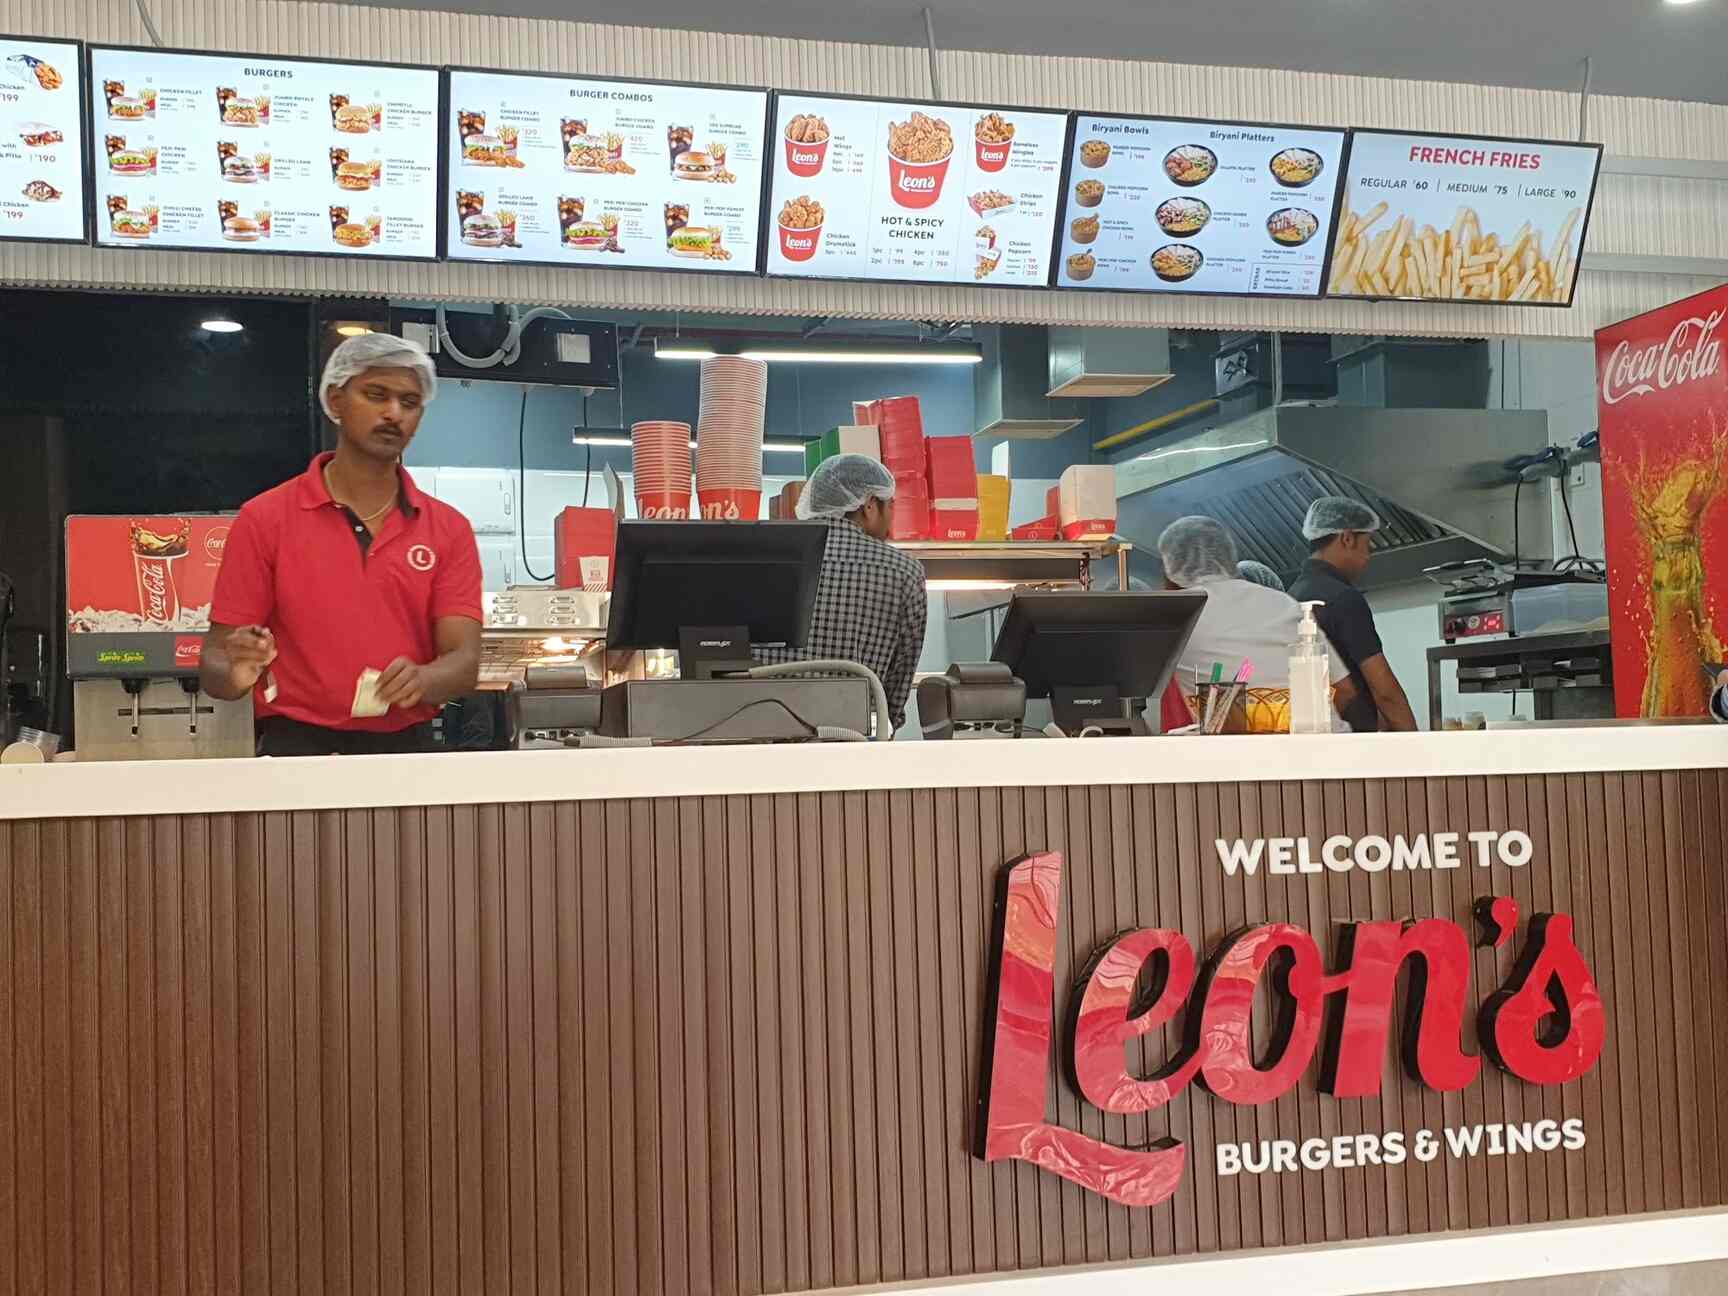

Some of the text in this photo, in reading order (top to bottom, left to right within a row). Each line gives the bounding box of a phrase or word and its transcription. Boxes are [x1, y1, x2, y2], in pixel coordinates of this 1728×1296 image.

[244, 68, 294, 79] BURGERS
[570, 88, 654, 102] BURGER COMBOS
[1092, 123, 1149, 134] Biryani Bowls
[1210, 130, 1275, 142] Biryani Platters
[1409, 146, 1541, 170] FRENCH FRIES
[898, 170, 936, 192] Leon's
[1360, 178, 1408, 189] REGULAR
[1446, 183, 1488, 194] MEDIUM
[1524, 187, 1556, 198] LARGE
[881, 216, 944, 228] HOT & SPICY
[888, 230, 934, 240] CHICKEN
[1215, 830, 1533, 876] WELCOME TO
[978, 850, 1606, 1206] Leon's
[1216, 1118, 1586, 1175] BURGERS & WINGS
